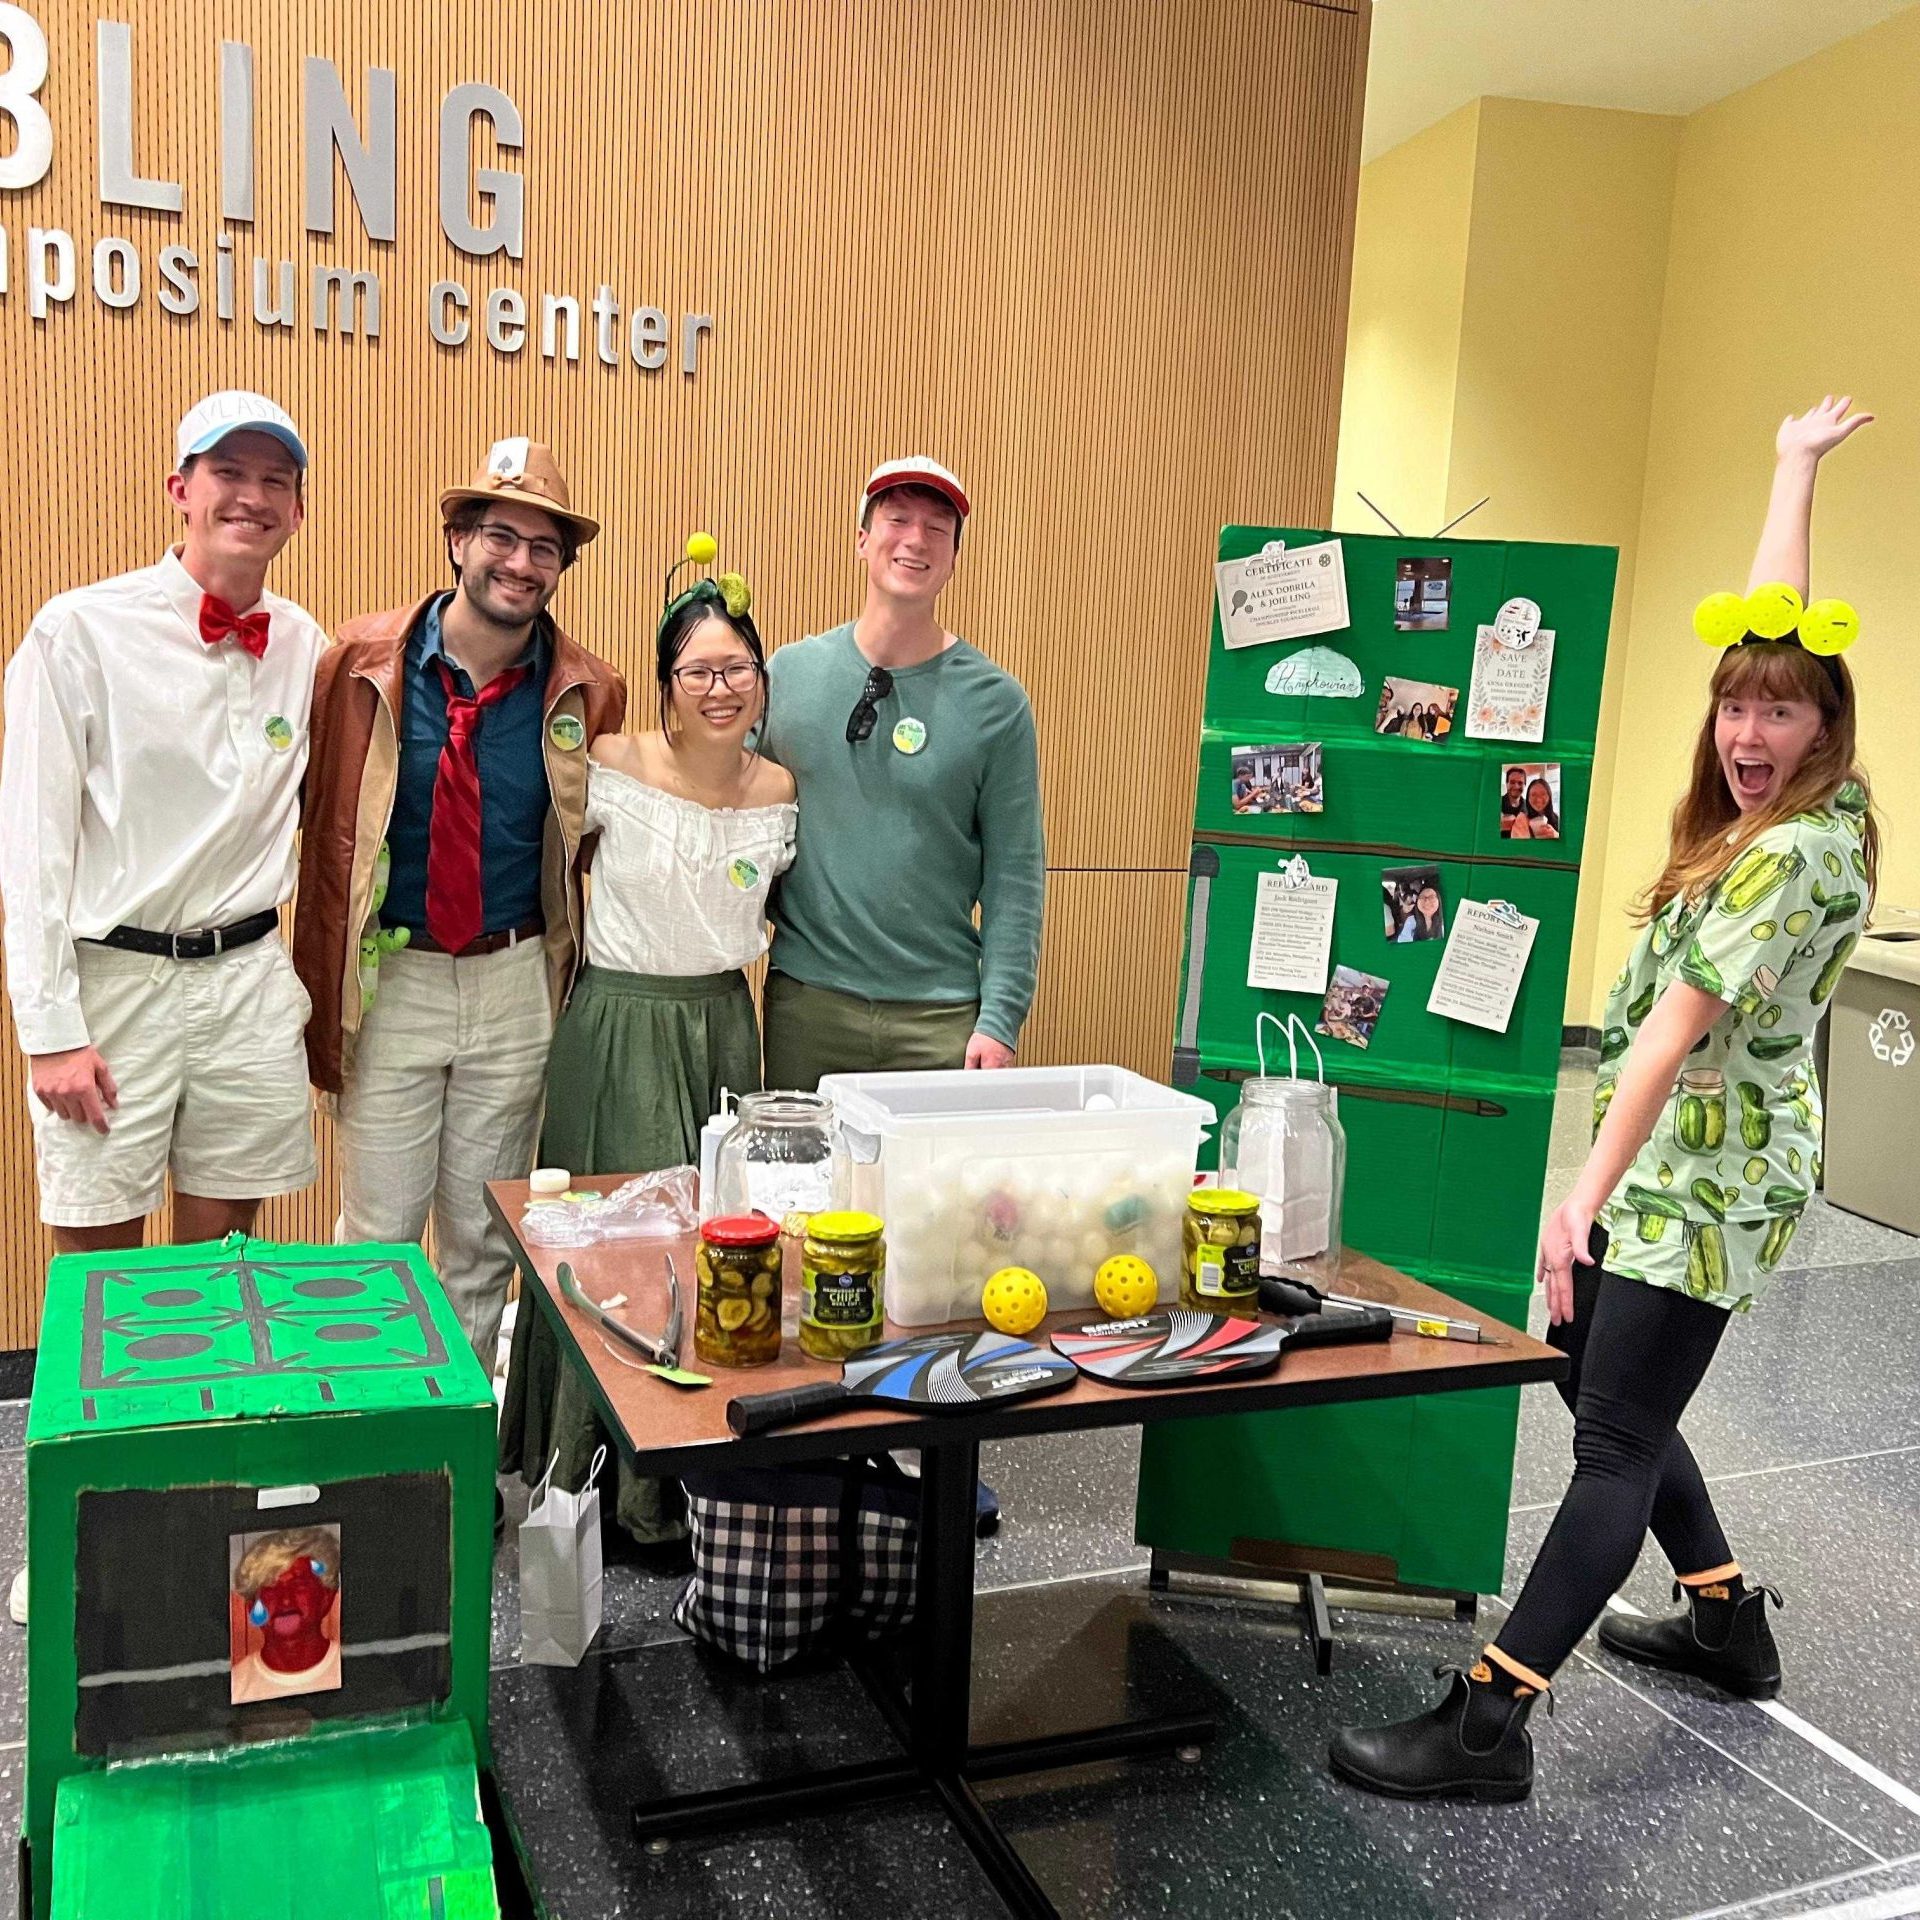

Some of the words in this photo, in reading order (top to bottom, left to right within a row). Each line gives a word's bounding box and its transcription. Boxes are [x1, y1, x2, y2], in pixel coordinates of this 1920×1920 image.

[0, 222, 380, 337] posium
[430, 281, 713, 375] center
[1245, 557, 1313, 577] CERTIFICATE
[1250, 588, 1274, 599] ALEX
[1276, 581, 1316, 595] DOBRILA
[1269, 596, 1288, 608] JOIE
[1290, 592, 1311, 603] LING
[1500, 653, 1528, 664] SAVE
[1496, 668, 1526, 679] DATE
[1467, 908, 1502, 923] REPORT
[829, 1292, 860, 1302] CHIPS
[1081, 1319, 1150, 1333] SPORT
